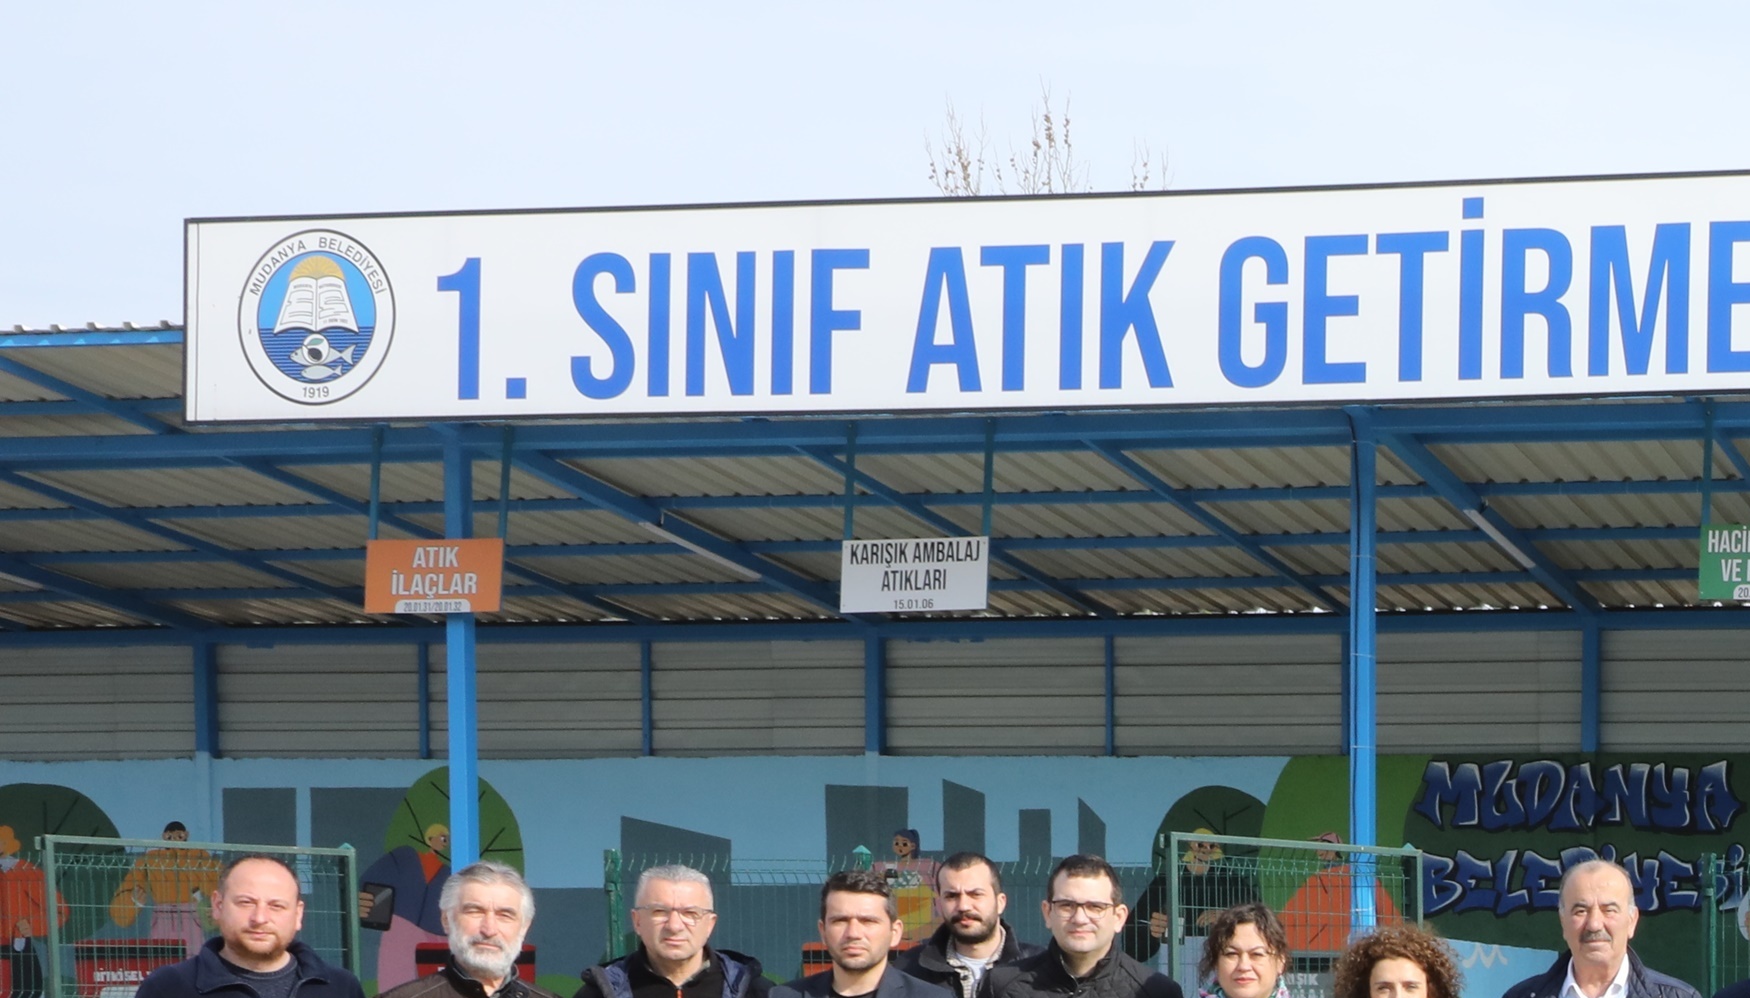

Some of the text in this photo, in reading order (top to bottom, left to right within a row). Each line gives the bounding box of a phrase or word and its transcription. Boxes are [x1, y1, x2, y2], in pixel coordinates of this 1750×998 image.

[249, 236, 387, 296] MUDANYA BELEDİYESİ
[436, 256, 527, 400] 1.
[570, 248, 871, 399] SINIF
[905, 239, 1176, 393] ATIK
[302, 386, 329, 398] 1919
[412, 546, 460, 568] ATIK
[850, 540, 980, 568] KARIŞIK AMBALAJ
[881, 569, 947, 591] ATIKLARI
[1721, 559, 1742, 582] VE
[391, 570, 477, 599] İLAÇLAR
[894, 599, 934, 609] 15.01.06
[1413, 759, 1744, 832] MUDANYA
